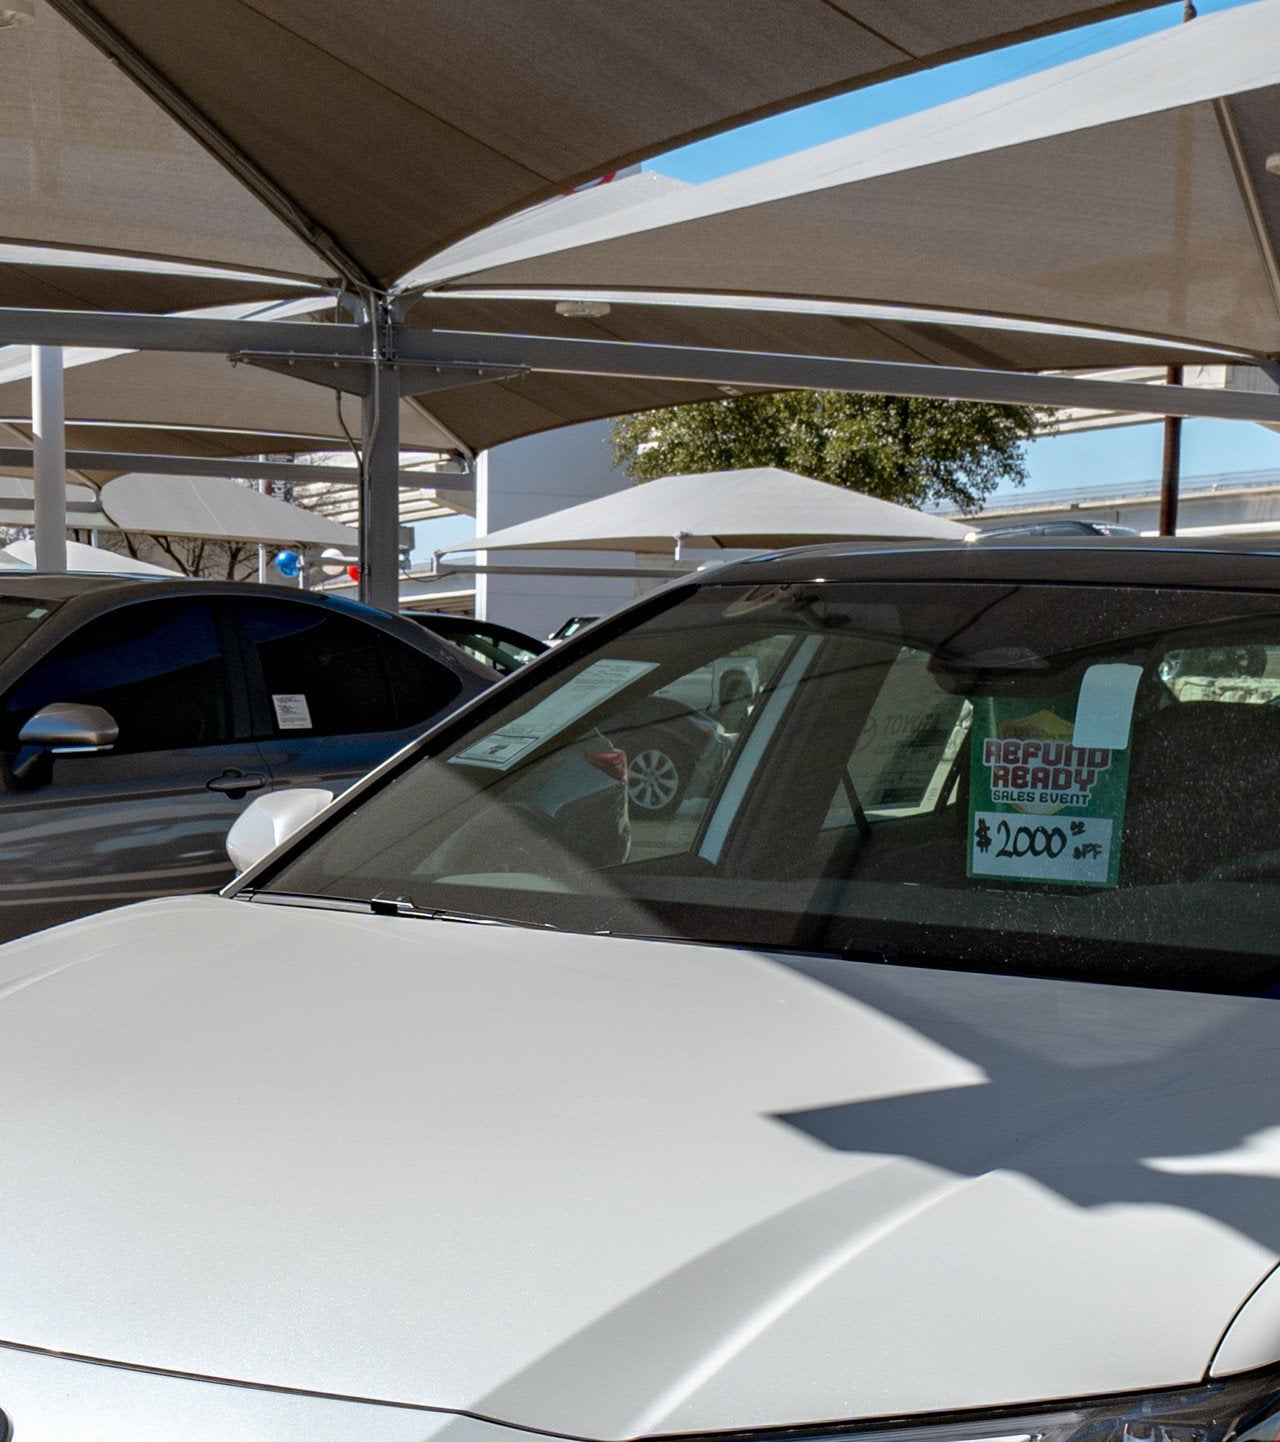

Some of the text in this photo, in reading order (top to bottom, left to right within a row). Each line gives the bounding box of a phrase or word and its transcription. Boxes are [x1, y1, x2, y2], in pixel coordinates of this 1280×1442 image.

[984, 740, 1110, 769] REFUND
[992, 765, 1096, 792] READY
[992, 790, 1090, 805] SALES EVENT
